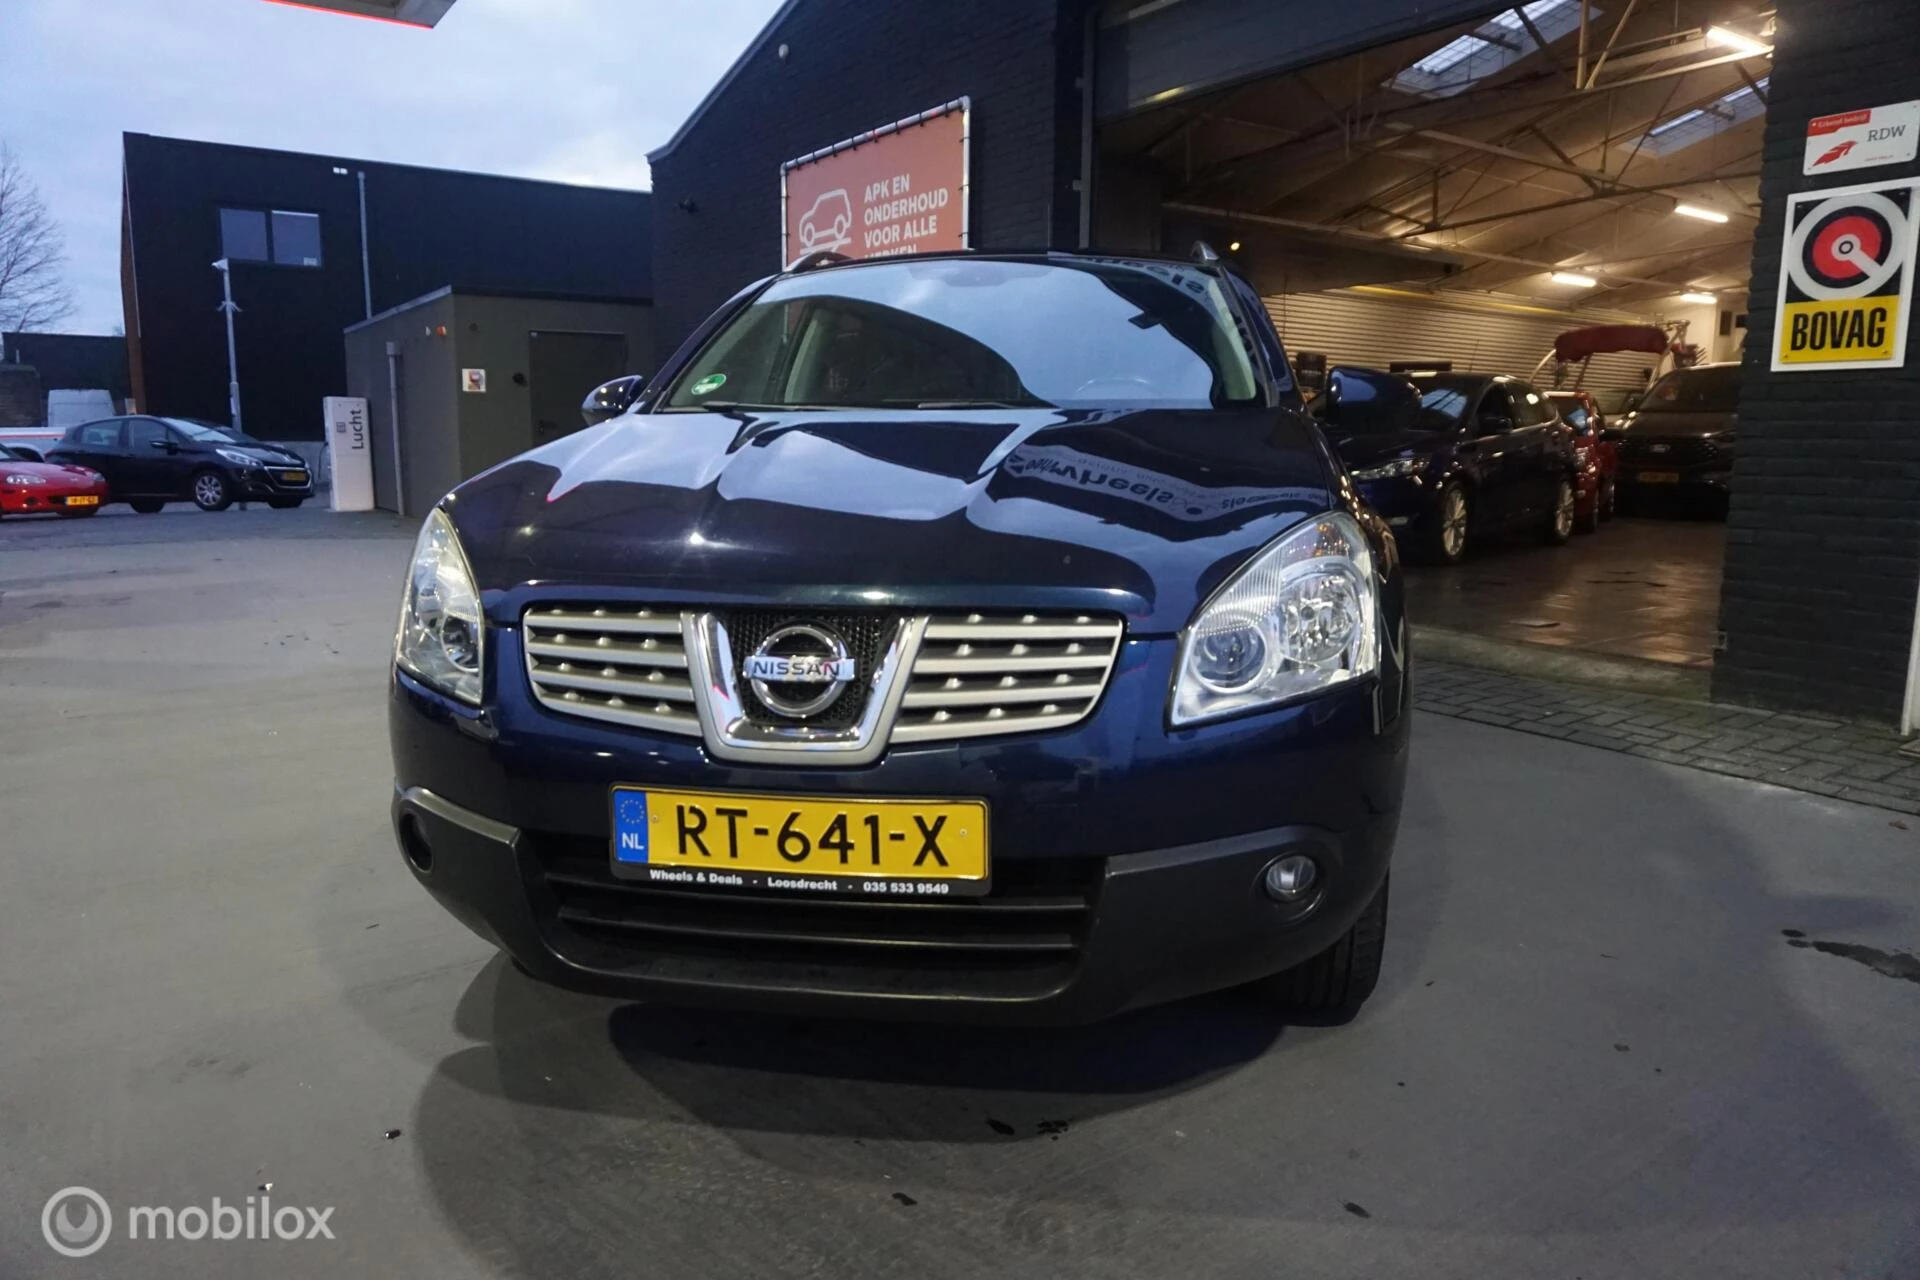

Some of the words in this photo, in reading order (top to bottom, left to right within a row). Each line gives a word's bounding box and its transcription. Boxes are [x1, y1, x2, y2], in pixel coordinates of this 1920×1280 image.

[1867, 125, 1907, 142] RDW
[864, 180, 889, 202] APK
[893, 174, 910, 194] EN
[864, 188, 948, 225] ONDERHOUD
[864, 225, 900, 248] VOOR
[903, 215, 937, 239] ALLE
[1790, 307, 1888, 351] BOVAG
[348, 408, 365, 450] Lucht
[753, 661, 840, 676] NISSAN
[621, 832, 644, 850] NL
[675, 804, 950, 867] RT-641-X
[650, 869, 693, 882] Wheels
[696, 872, 706, 883] &
[709, 873, 743, 885] Deals
[767, 876, 838, 891] Loosdrecht
[863, 881, 887, 893] 035
[890, 882, 914, 894] 533
[917, 883, 949, 895] 9549
